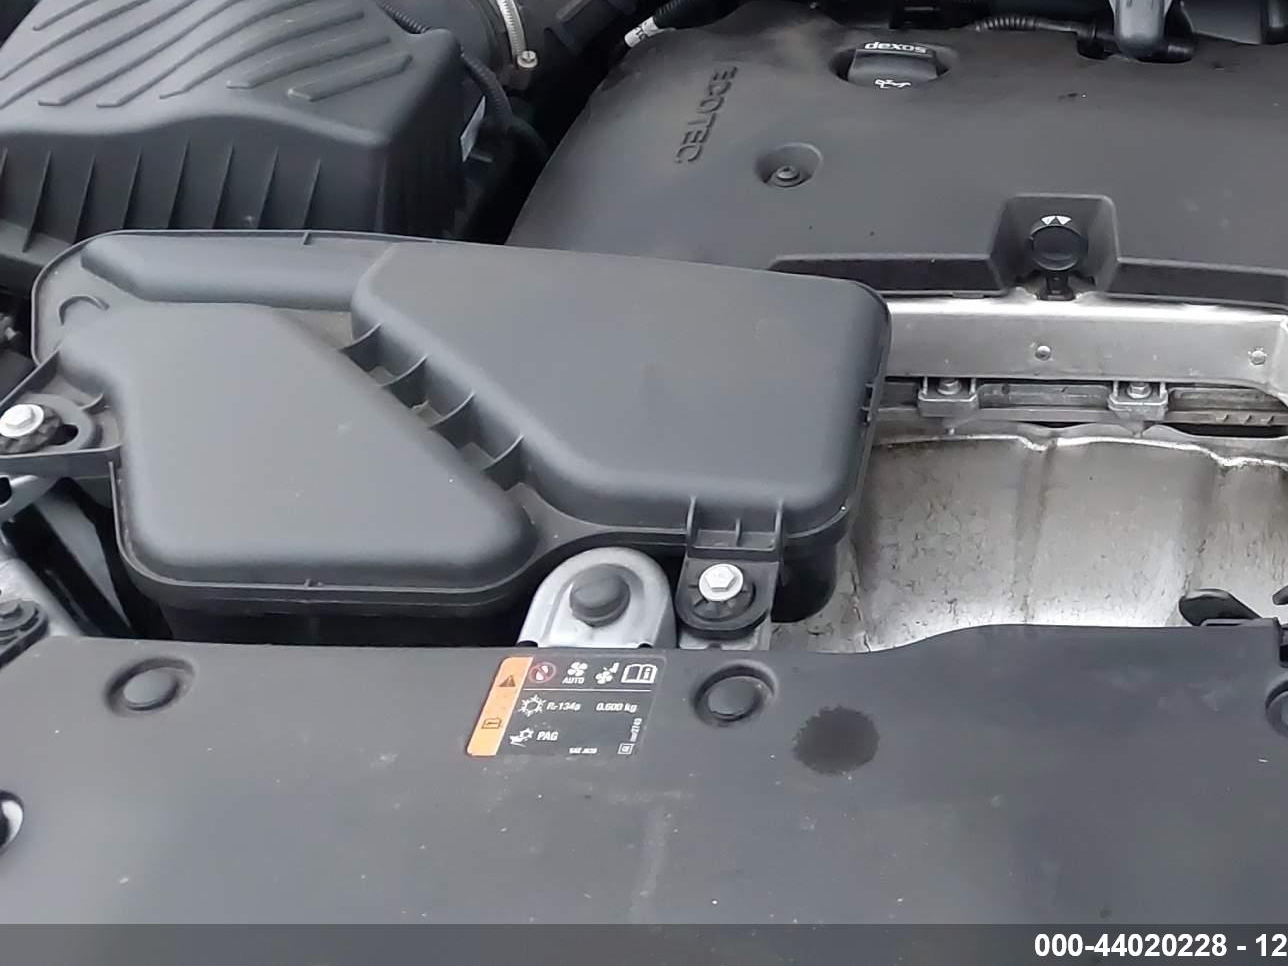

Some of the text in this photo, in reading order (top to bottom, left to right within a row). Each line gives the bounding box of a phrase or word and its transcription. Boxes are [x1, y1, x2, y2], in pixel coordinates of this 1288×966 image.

[864, 41, 927, 54] dexos
[675, 65, 738, 164] ECOTEC
[561, 676, 585, 685] AUTO
[623, 702, 638, 713] kg
[536, 731, 559, 742] PAG
